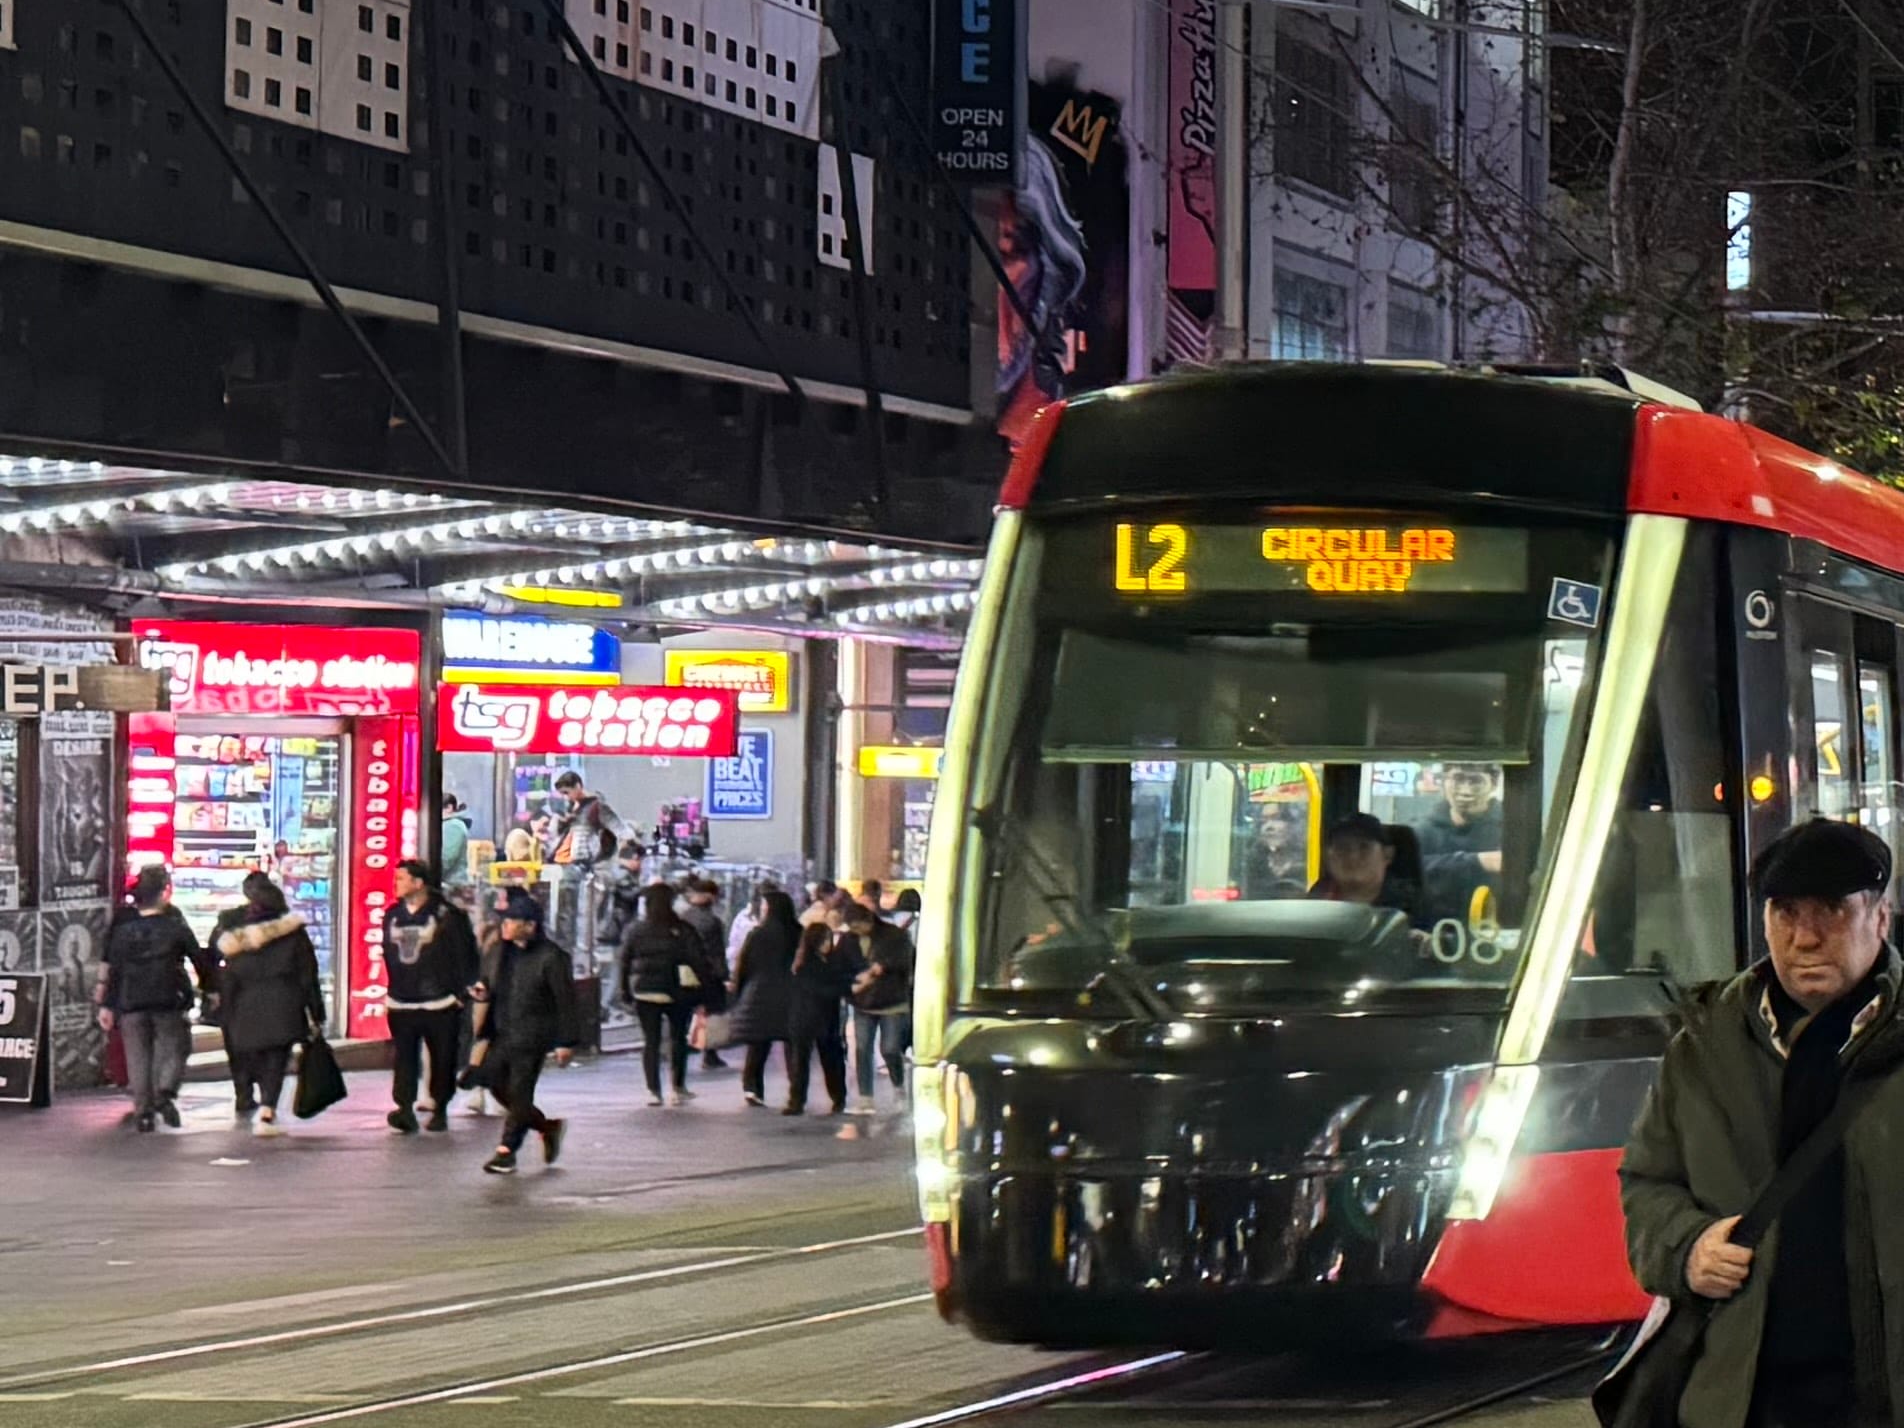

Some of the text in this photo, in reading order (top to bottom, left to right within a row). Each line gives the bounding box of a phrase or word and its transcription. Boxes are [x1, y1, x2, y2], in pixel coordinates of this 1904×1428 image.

[942, 109, 1004, 126] OPEN
[1180, 54, 1216, 156] Pizza
[962, 131, 988, 147] 24
[937, 151, 1009, 170] HOURS
[1116, 523, 1454, 590] L2 CIRCULAR
[1307, 560, 1411, 591] QUAY
[548, 690, 721, 724] tobacco
[557, 715, 711, 748] station
[714, 757, 764, 781] BEAT
[365, 737, 391, 869] tobacco
[1432, 918, 1502, 965] 08
